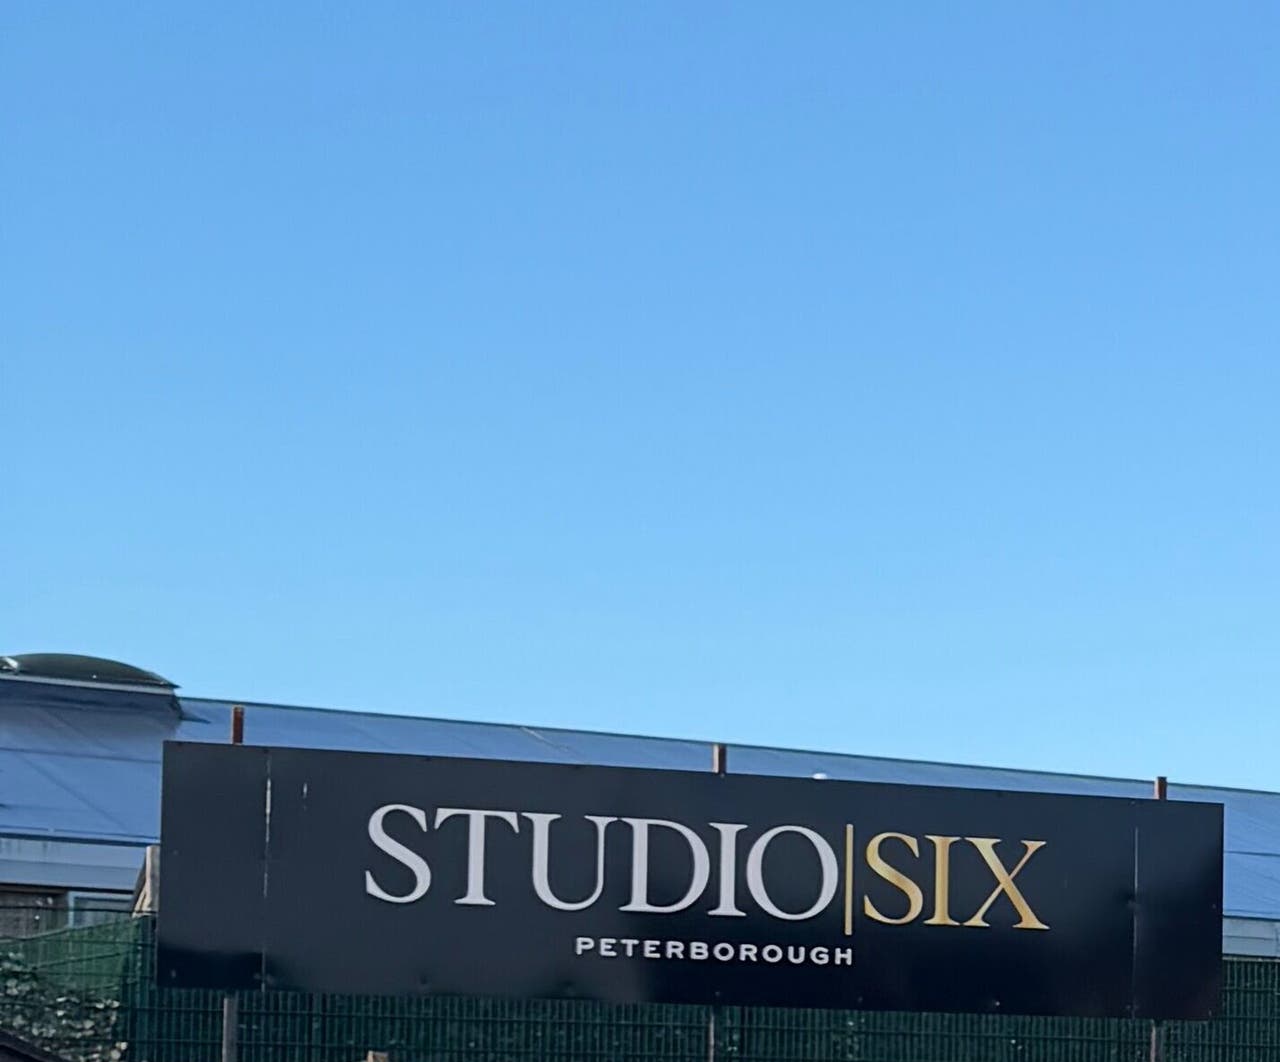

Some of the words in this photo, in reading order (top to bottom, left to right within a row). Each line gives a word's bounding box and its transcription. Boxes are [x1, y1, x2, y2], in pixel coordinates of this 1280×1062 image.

[365, 803, 838, 921] STUDIO
[864, 831, 1050, 930] SIX
[575, 937, 853, 966] PETERBOROUGH
